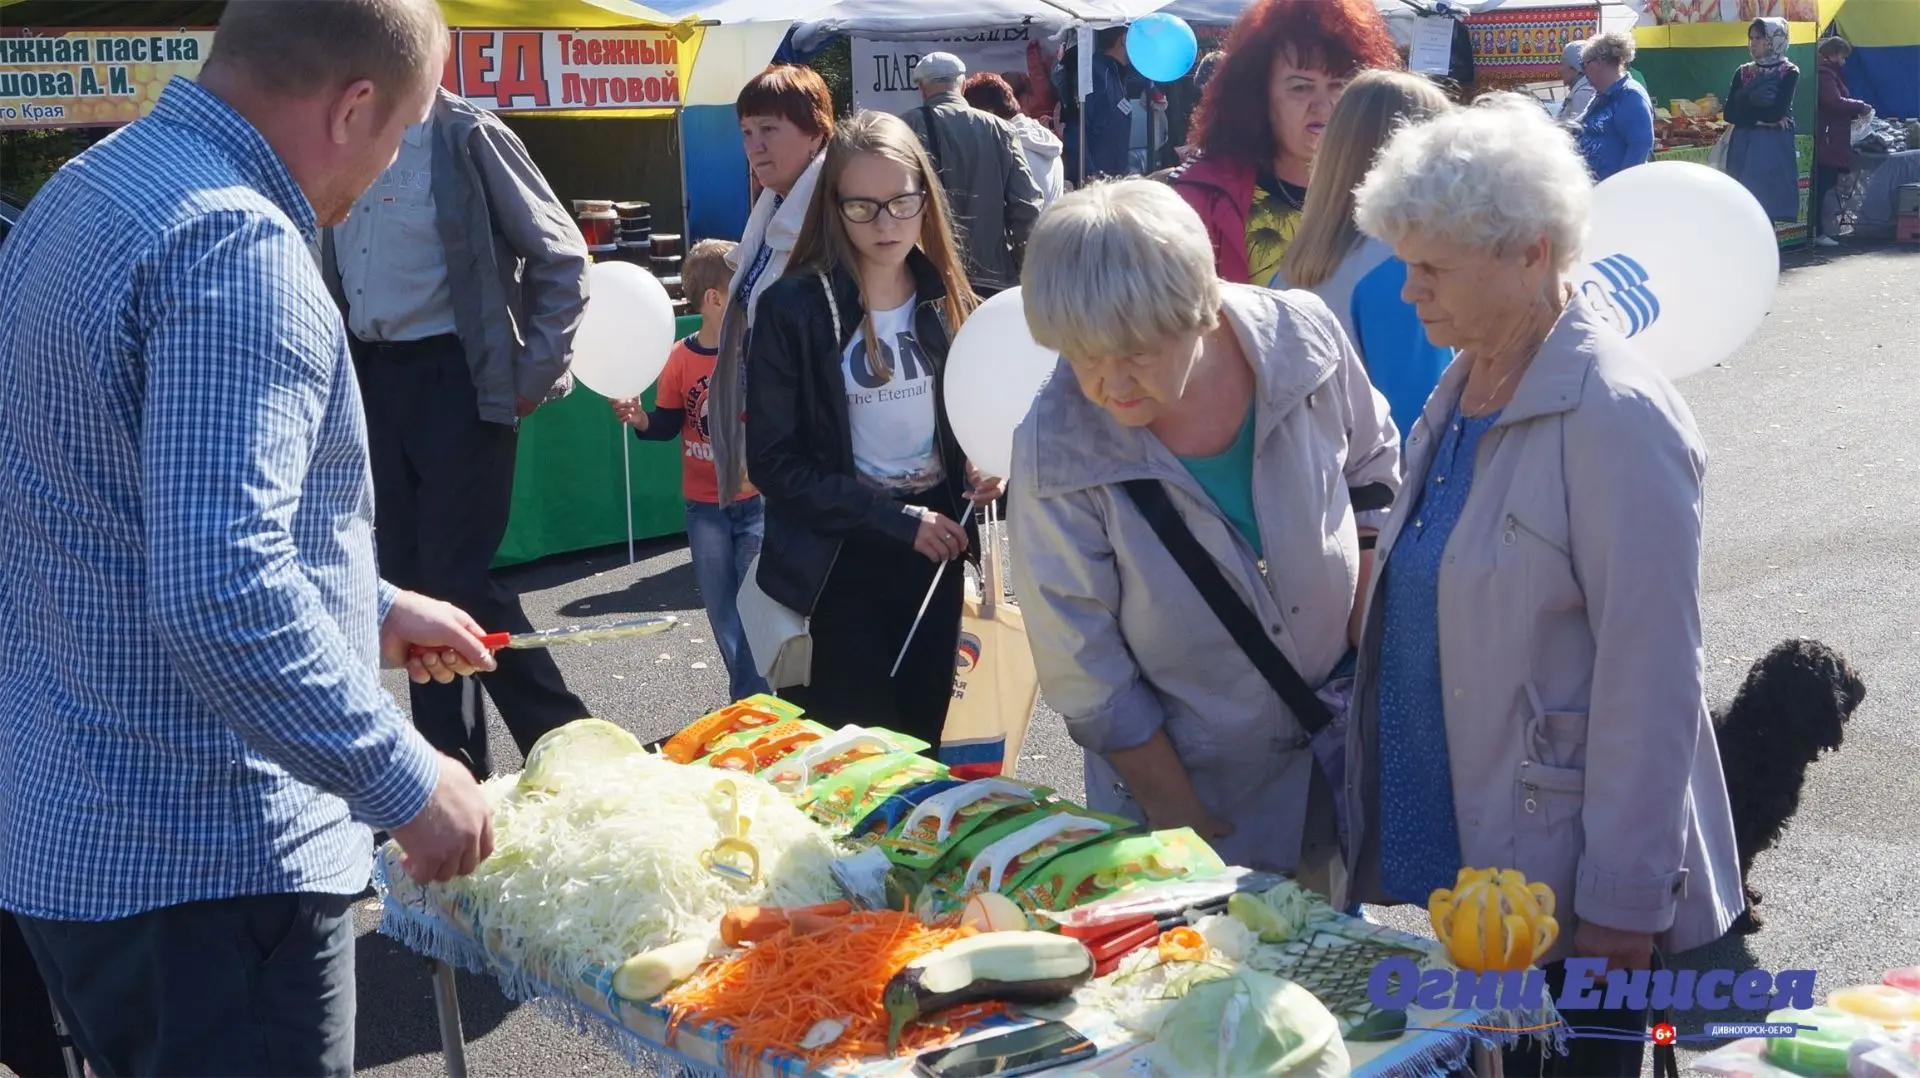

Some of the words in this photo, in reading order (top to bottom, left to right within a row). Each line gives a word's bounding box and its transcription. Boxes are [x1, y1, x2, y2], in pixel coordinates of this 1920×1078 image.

[558, 33, 678, 65] Таежный
[80, 67, 104, 95] А.
[109, 67, 135, 94] И.
[561, 70, 680, 107] Луговой
[22, 104, 64, 121] Края
[847, 393, 872, 405] The
[878, 380, 927, 402] Eternal
